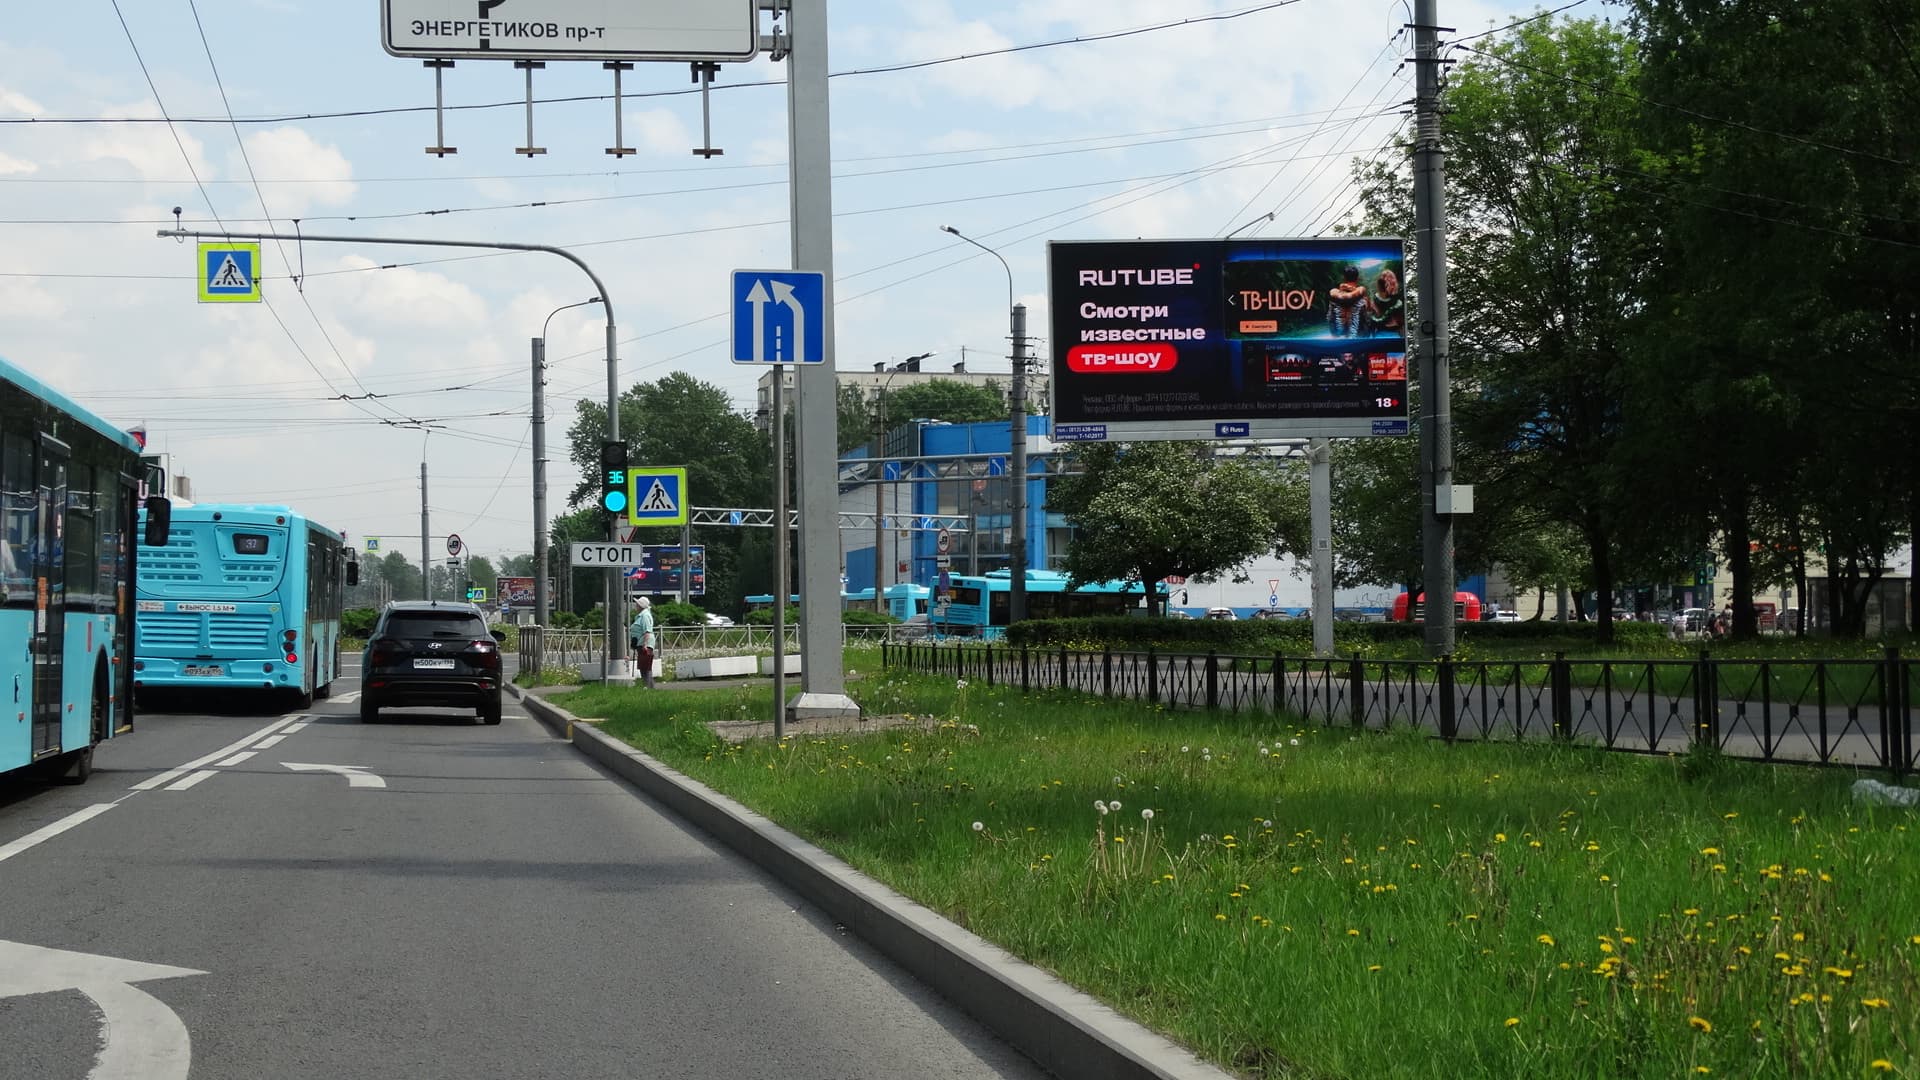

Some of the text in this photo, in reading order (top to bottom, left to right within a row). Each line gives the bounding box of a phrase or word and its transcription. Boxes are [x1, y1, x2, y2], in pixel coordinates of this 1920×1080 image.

[411, 20, 605, 42] ЭНЕРГЕТИКОВ пр-т
[1079, 268, 1194, 286] RUTUBE
[1240, 289, 1315, 310] ТВ-ШОУ
[1080, 302, 1169, 321] Смотри
[1081, 327, 1206, 342] известные
[1081, 352, 1161, 368] тв-шоу
[608, 471, 624, 484] 36
[581, 547, 632, 562] СТОП
